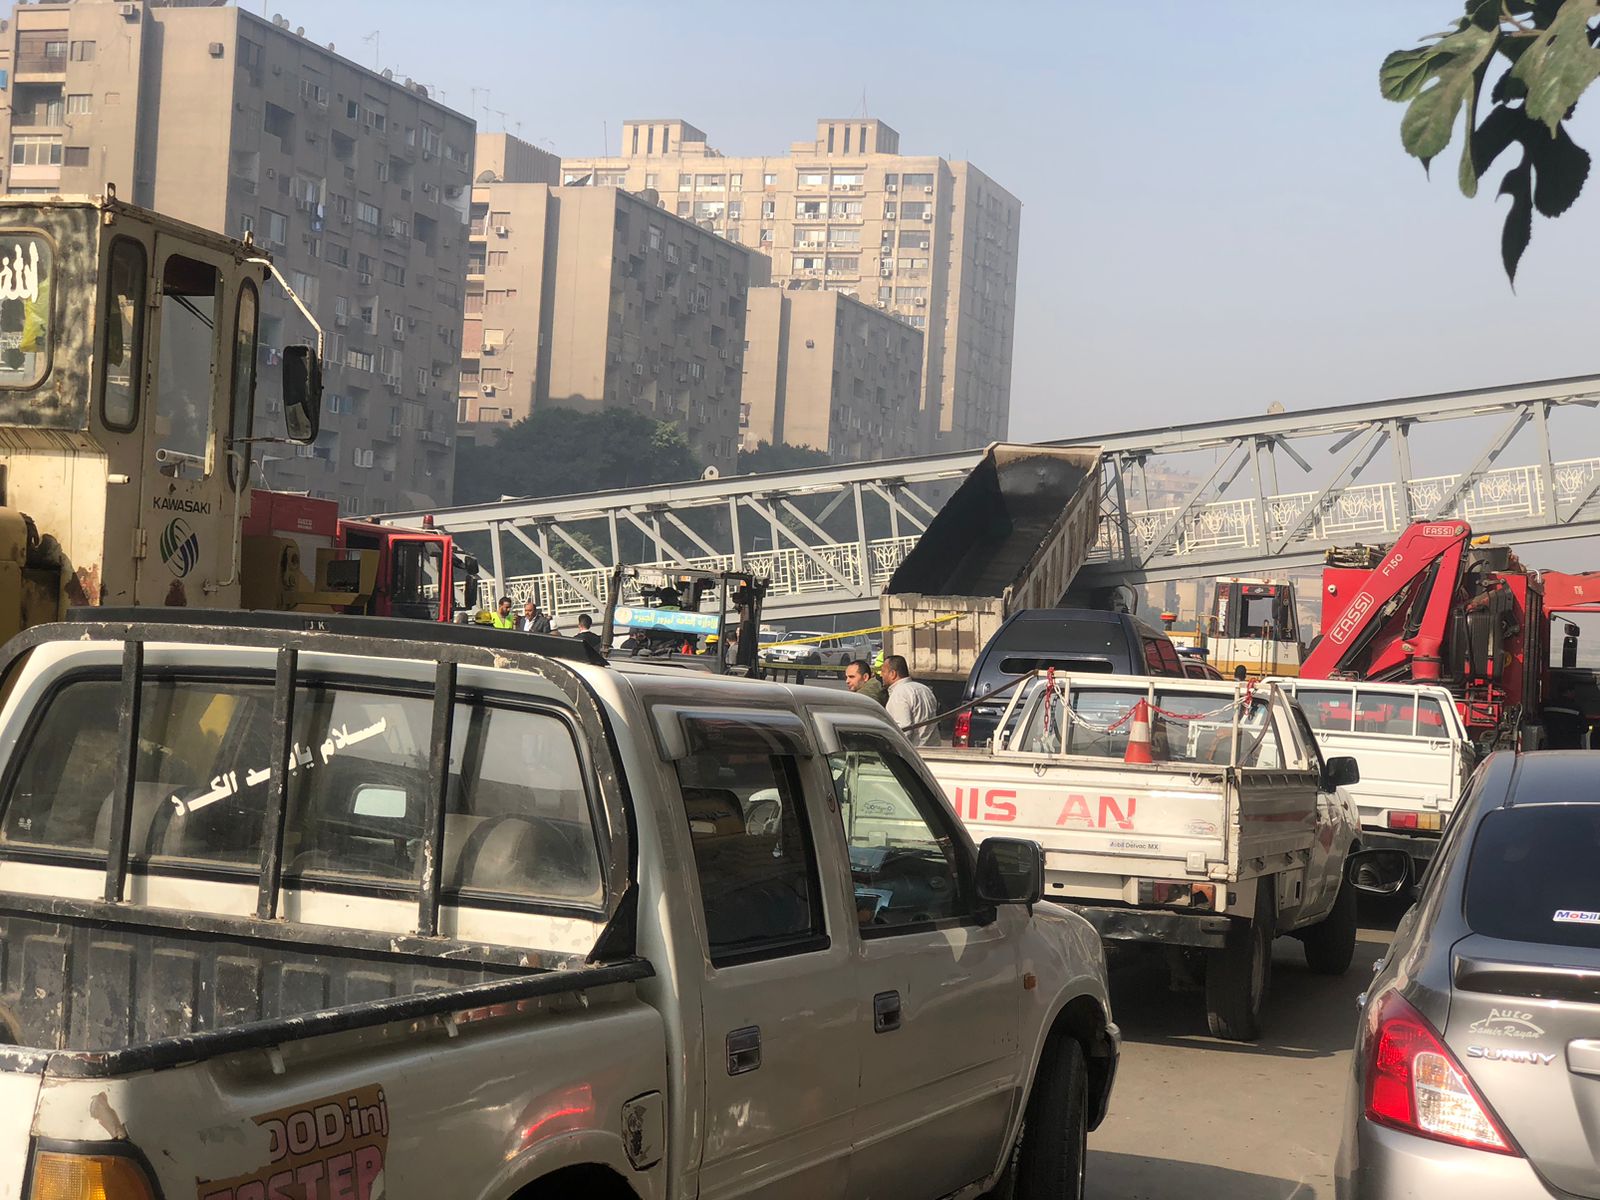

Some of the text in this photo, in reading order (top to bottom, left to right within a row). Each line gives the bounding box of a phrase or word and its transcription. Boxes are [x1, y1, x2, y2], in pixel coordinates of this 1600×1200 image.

[153, 496, 211, 515] KAWASAKI
[1425, 527, 1452, 535] FASSI
[1382, 553, 1403, 577] F150
[1333, 595, 1371, 641] FASSI
[320, 716, 387, 765] سلام
[1556, 911, 1598, 920] Mobil
[1466, 1045, 1557, 1066] SUNNY
